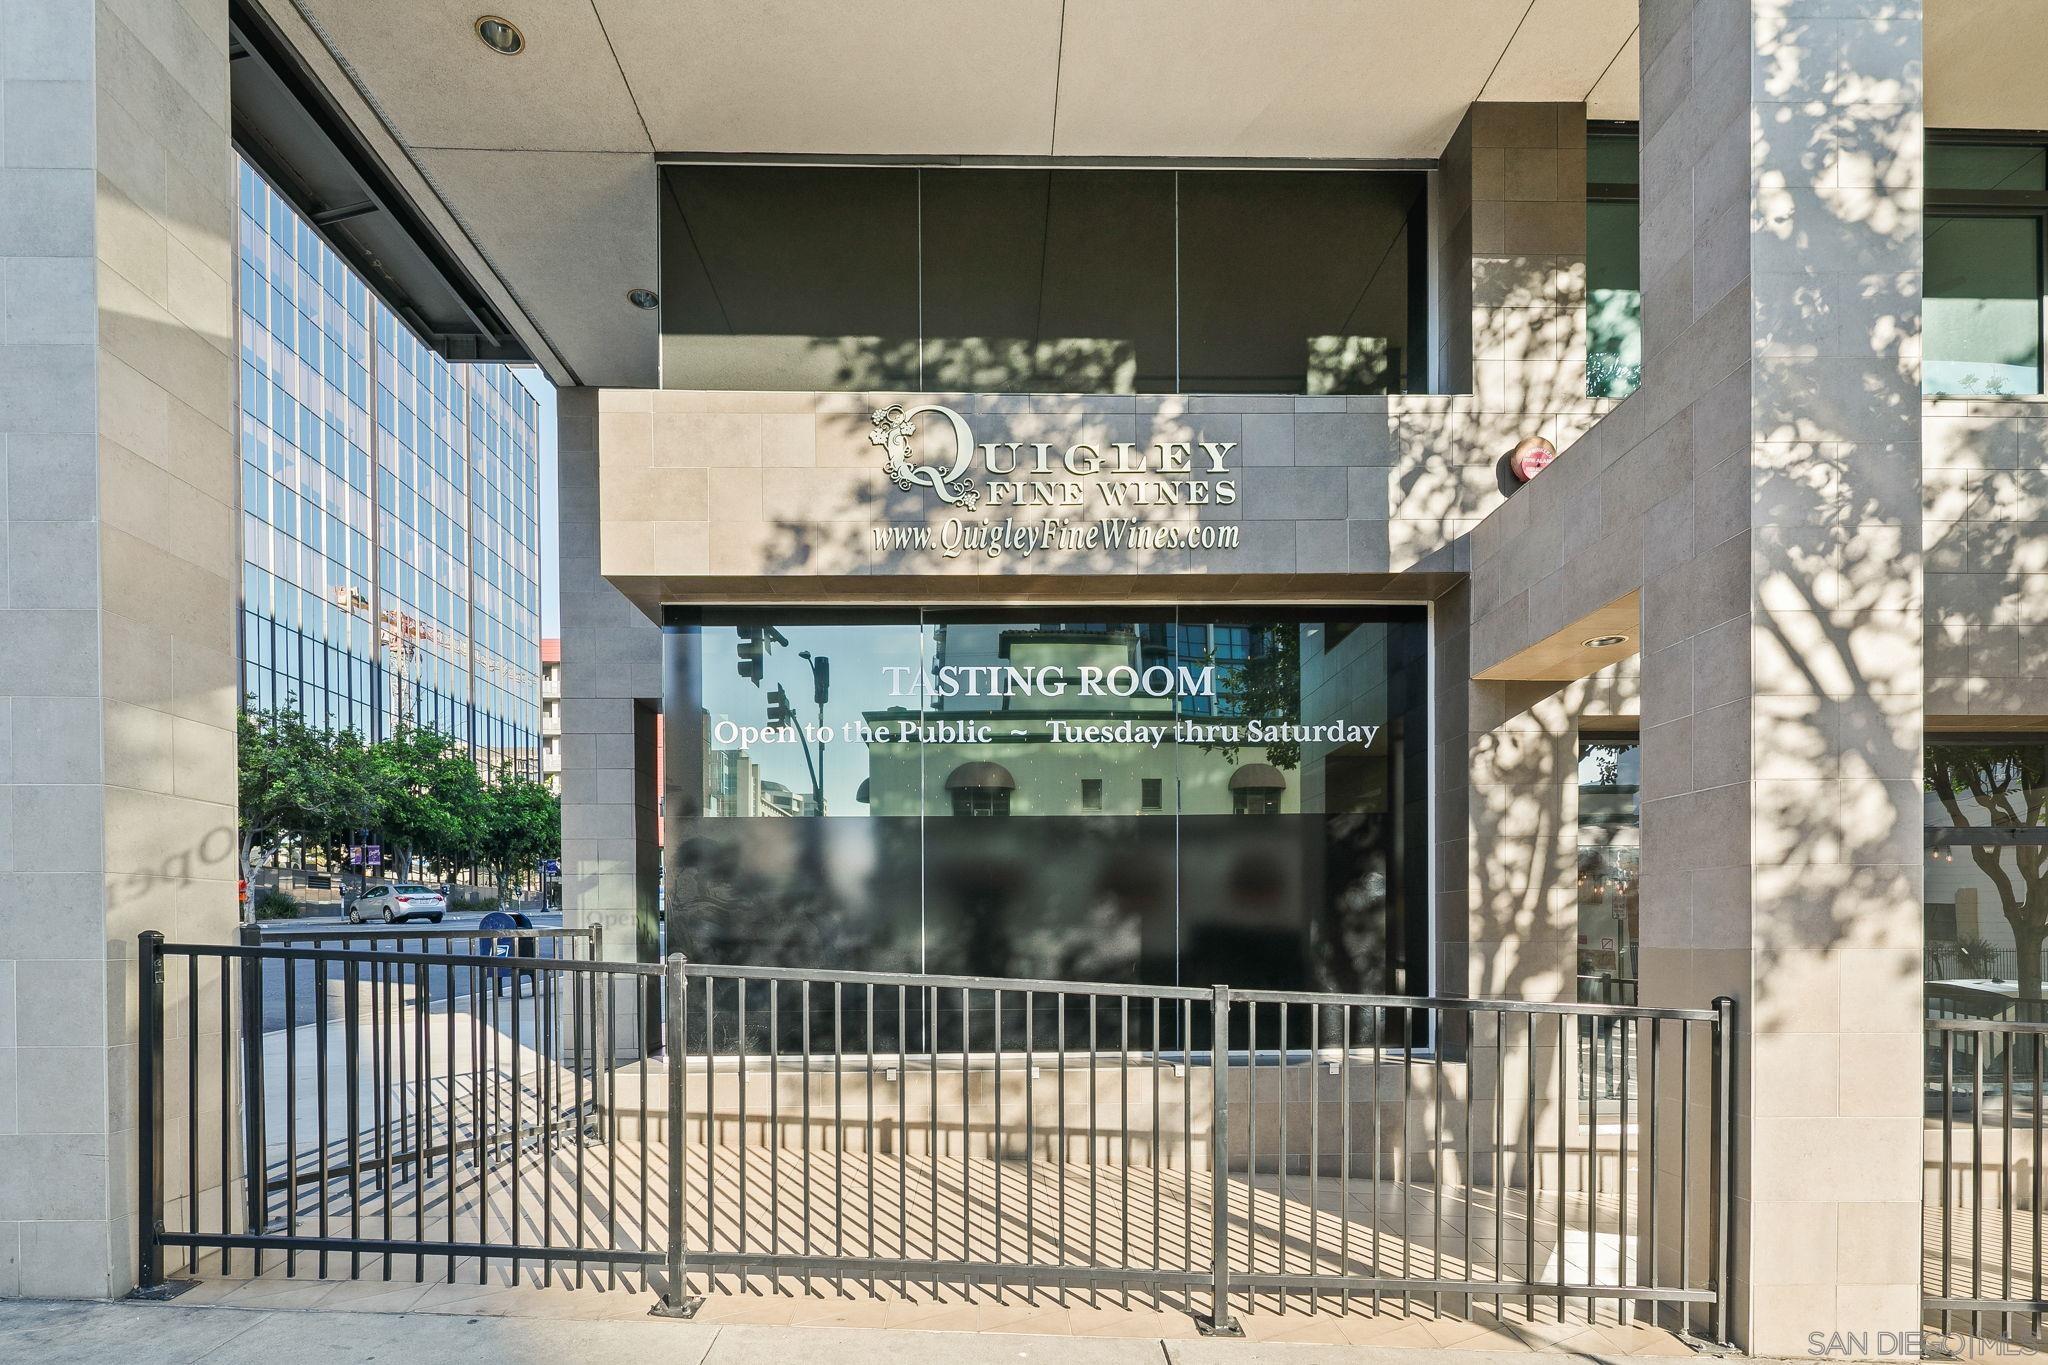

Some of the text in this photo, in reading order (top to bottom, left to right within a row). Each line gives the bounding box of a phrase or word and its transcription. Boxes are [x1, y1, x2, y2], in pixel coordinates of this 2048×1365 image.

[880, 403, 1238, 510] QUIGLEY
[986, 480, 1237, 506] FINE WINES
[873, 518, 1240, 558] www.QuigleyFineWines.com
[882, 666, 1216, 697] TASTING ROOM
[714, 720, 798, 749] Open
[807, 721, 834, 743] to
[842, 720, 890, 743] the
[897, 720, 992, 743] Public
[1046, 720, 1167, 749] Tuesday
[1174, 720, 1239, 743] thru
[1248, 720, 1379, 749] Saturday
